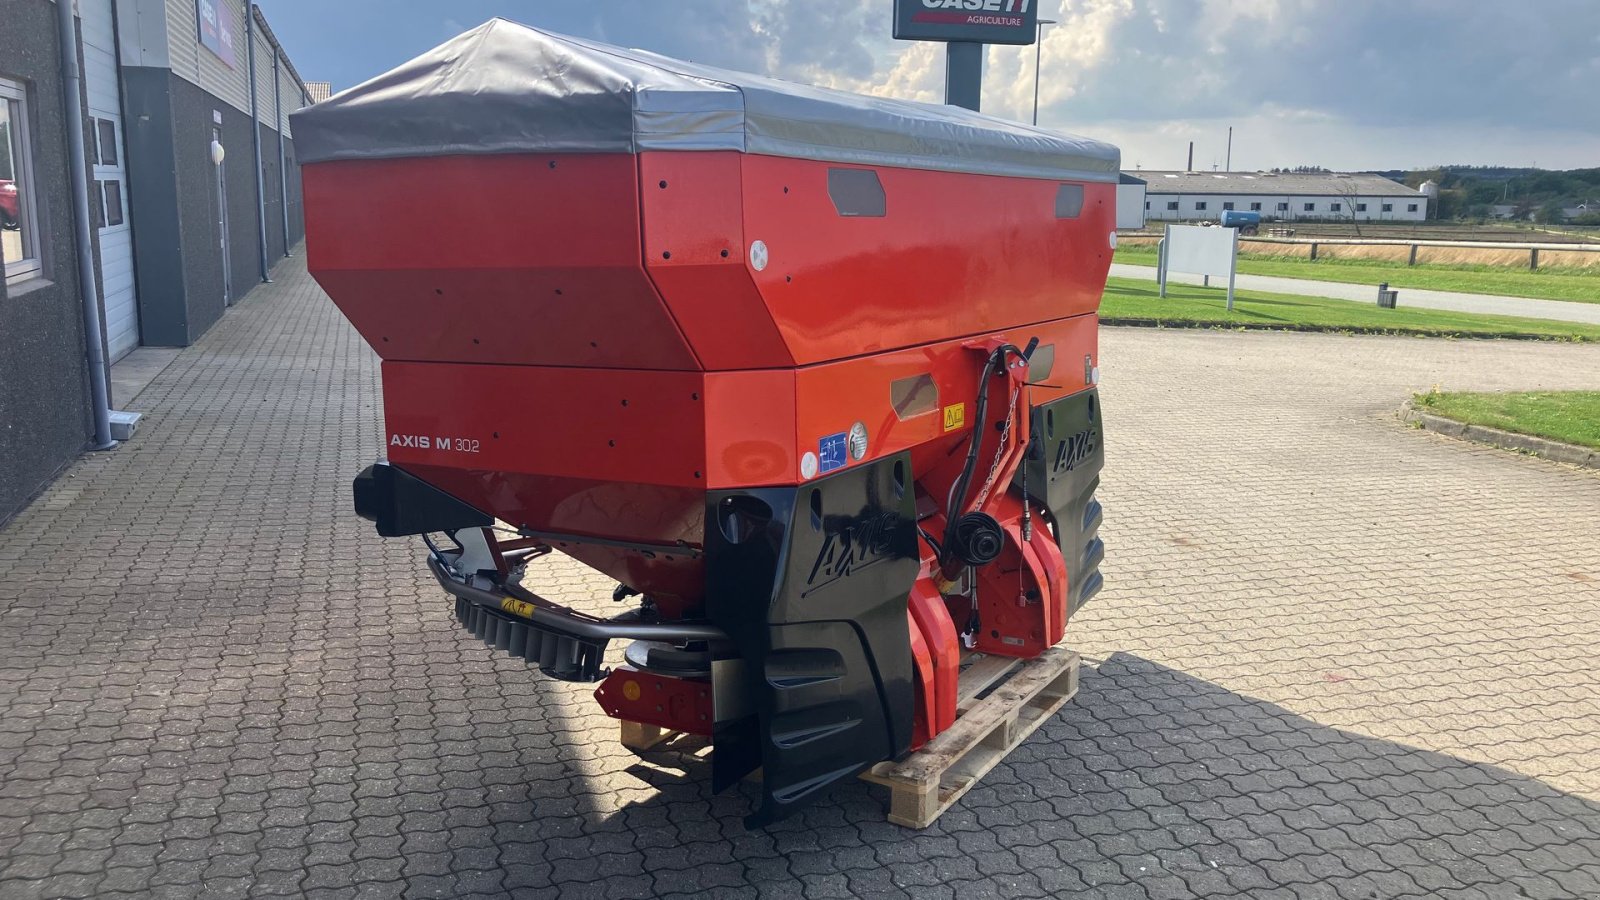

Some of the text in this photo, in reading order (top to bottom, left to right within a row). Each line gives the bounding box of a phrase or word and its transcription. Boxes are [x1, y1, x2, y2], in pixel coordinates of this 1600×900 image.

[966, 15, 1022, 26] AGRICULTURE
[390, 434, 430, 449] AXIS
[436, 437, 451, 450] M
[1053, 429, 1097, 473] AXIS
